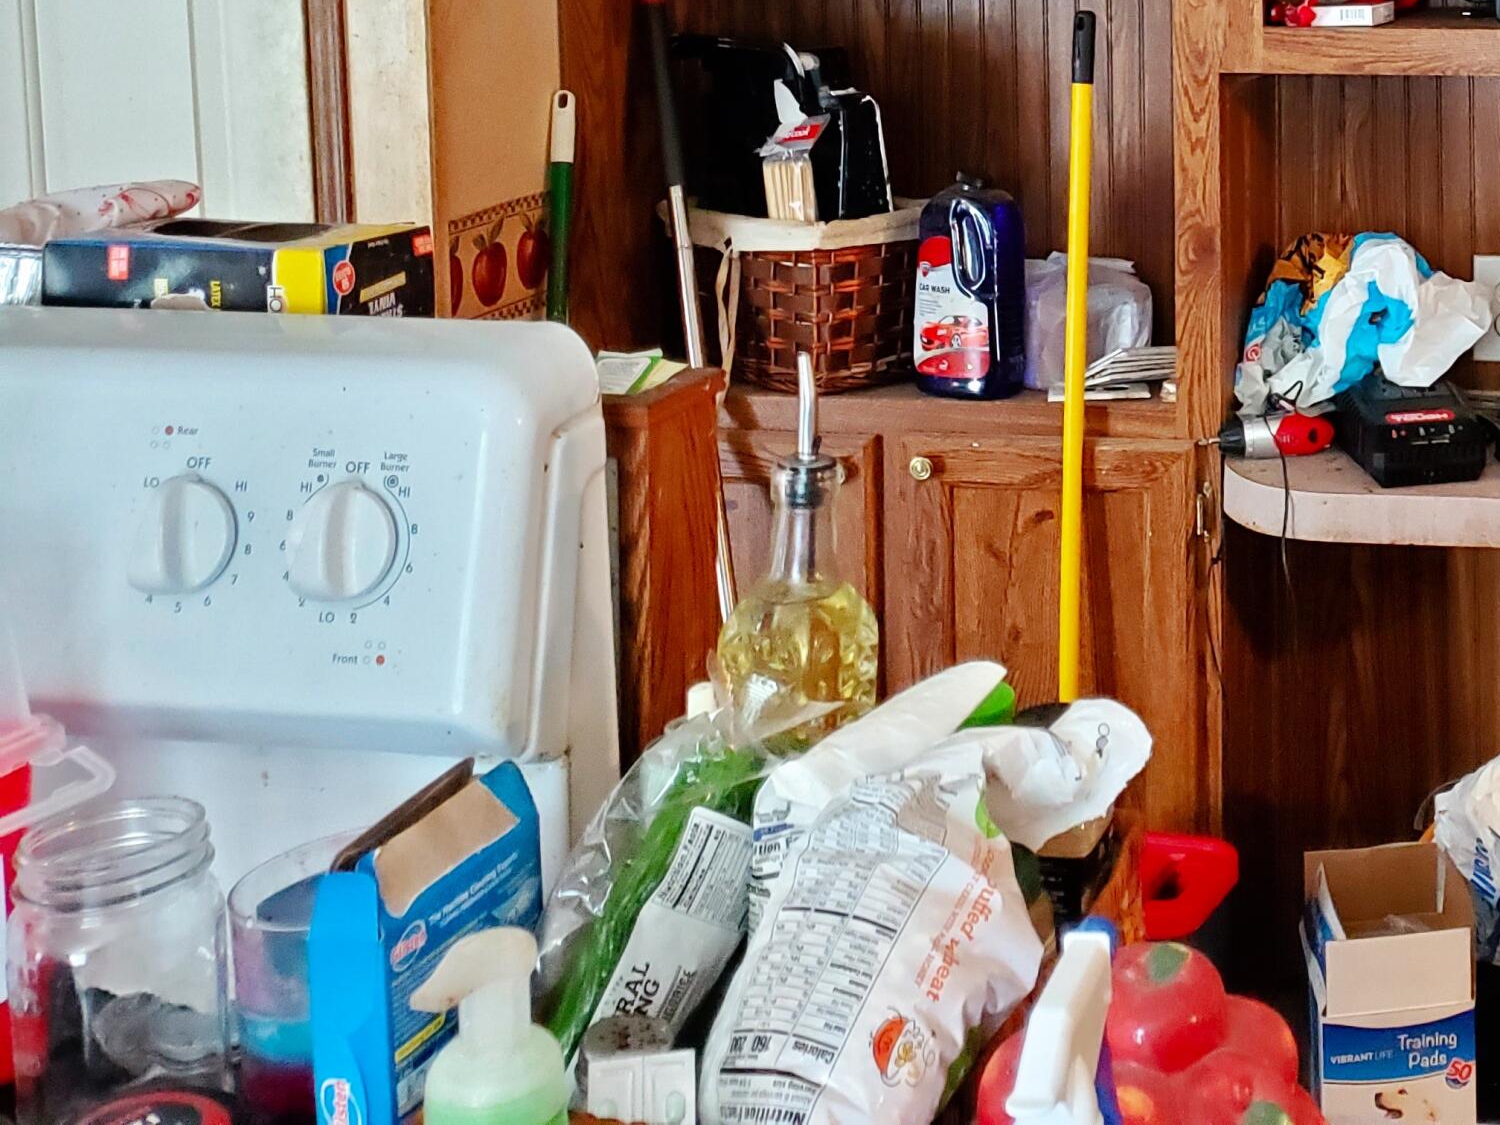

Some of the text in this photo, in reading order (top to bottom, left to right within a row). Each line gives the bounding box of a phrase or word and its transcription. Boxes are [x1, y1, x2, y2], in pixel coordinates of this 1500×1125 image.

[920, 283, 951, 294] CAR WASH
[177, 426, 199, 435] Rear
[313, 448, 336, 458] Small
[384, 452, 408, 462] Large
[186, 457, 212, 469] OFF
[308, 459, 337, 469] Burner
[345, 461, 371, 474] OFF
[380, 463, 410, 473] Burner
[144, 477, 160, 489] LO
[235, 481, 248, 492] HI
[300, 481, 313, 493] HI
[398, 486, 411, 498] HI
[247, 511, 255, 523] 9
[410, 523, 418, 534] 8
[244, 544, 252, 555] 8
[405, 562, 413, 574] 6
[231, 574, 238, 585] 7
[282, 570, 289, 581] 4
[204, 595, 212, 607] 6
[383, 595, 390, 606] 4
[174, 602, 182, 613] 5
[318, 612, 335, 623] LO
[350, 612, 357, 624] 2
[332, 653, 358, 665] Front
[926, 937, 961, 1003] wheat
[1397, 1031, 1458, 1051] Training
[792, 1040, 836, 1065] Calories
[1330, 1050, 1394, 1065] VIBRANT LIFE
[1408, 1051, 1448, 1070] Pads
[1447, 1060, 1473, 1081] 50
